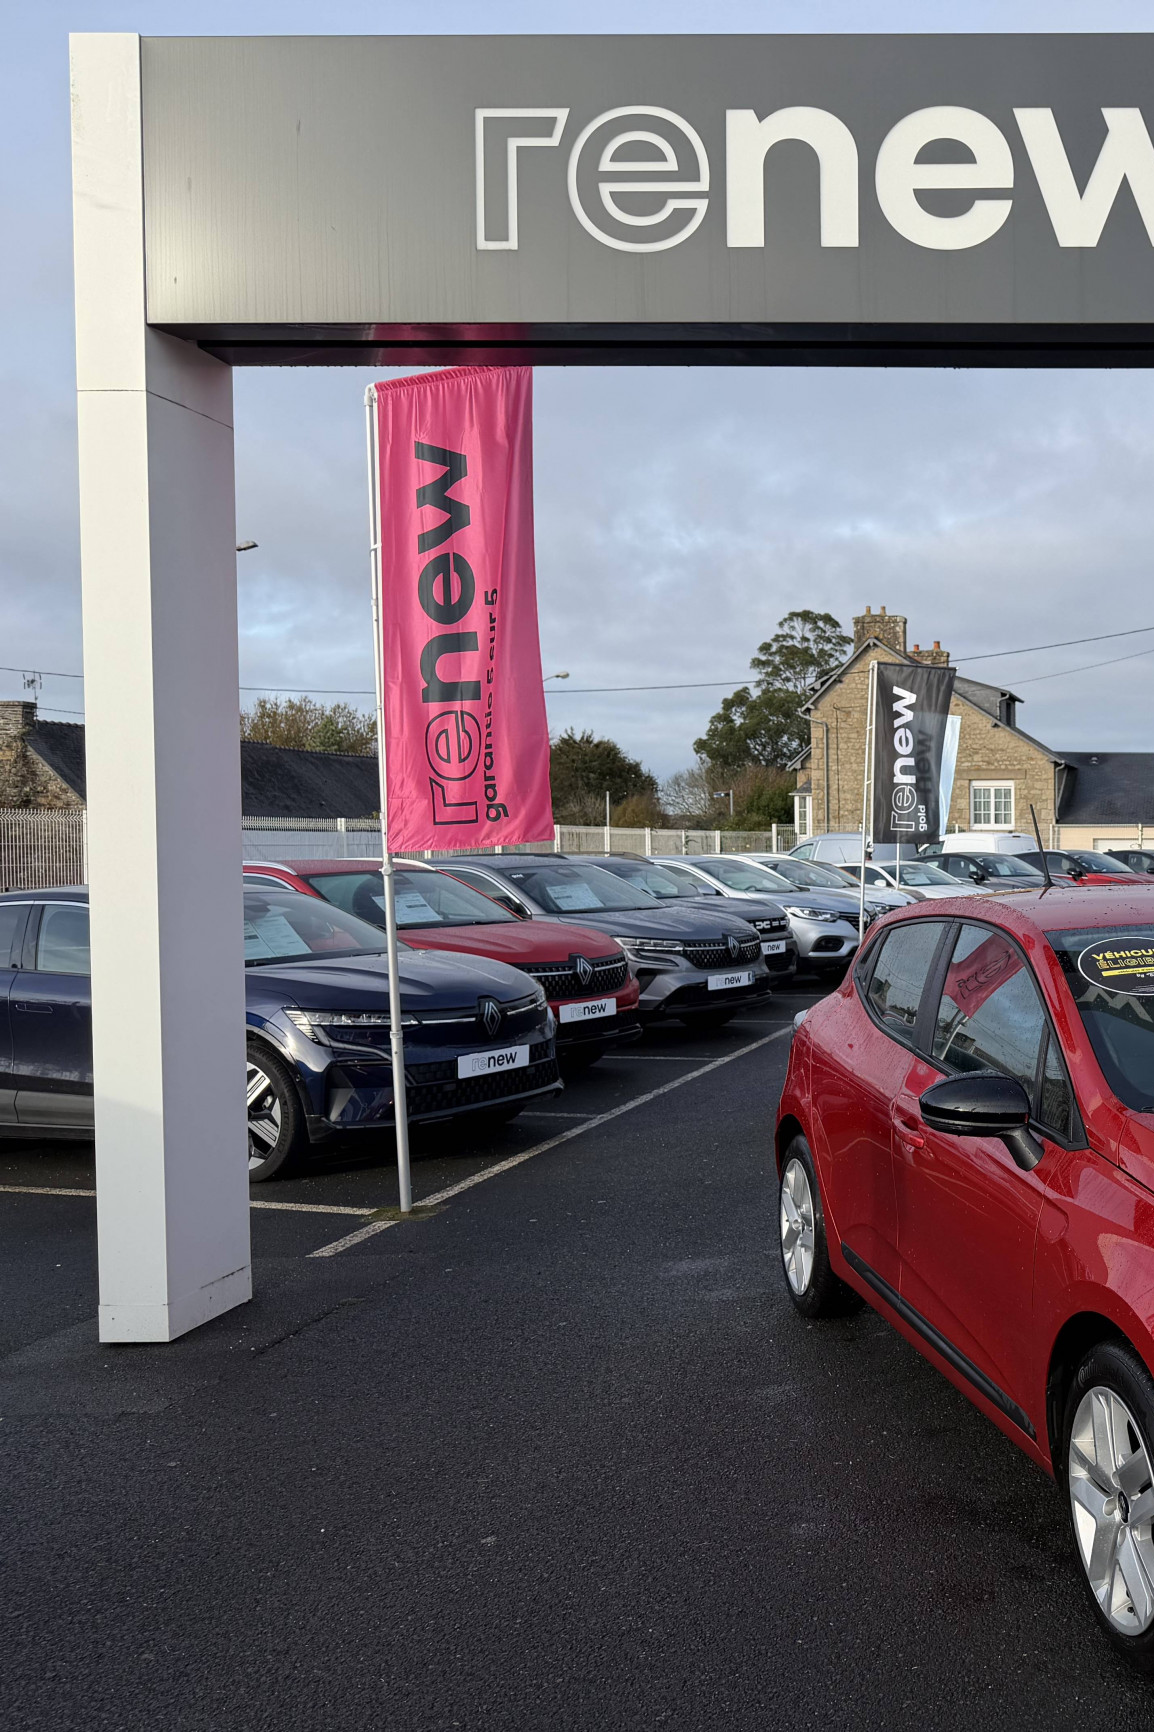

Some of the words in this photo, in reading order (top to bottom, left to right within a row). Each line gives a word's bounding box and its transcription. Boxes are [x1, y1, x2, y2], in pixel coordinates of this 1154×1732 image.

[485, 588, 498, 606] 5
[414, 440, 481, 826] renew
[890, 685, 917, 832] renew
[918, 804, 927, 832] gold
[571, 1003, 607, 1018] renew
[472, 1052, 518, 1072] renew
